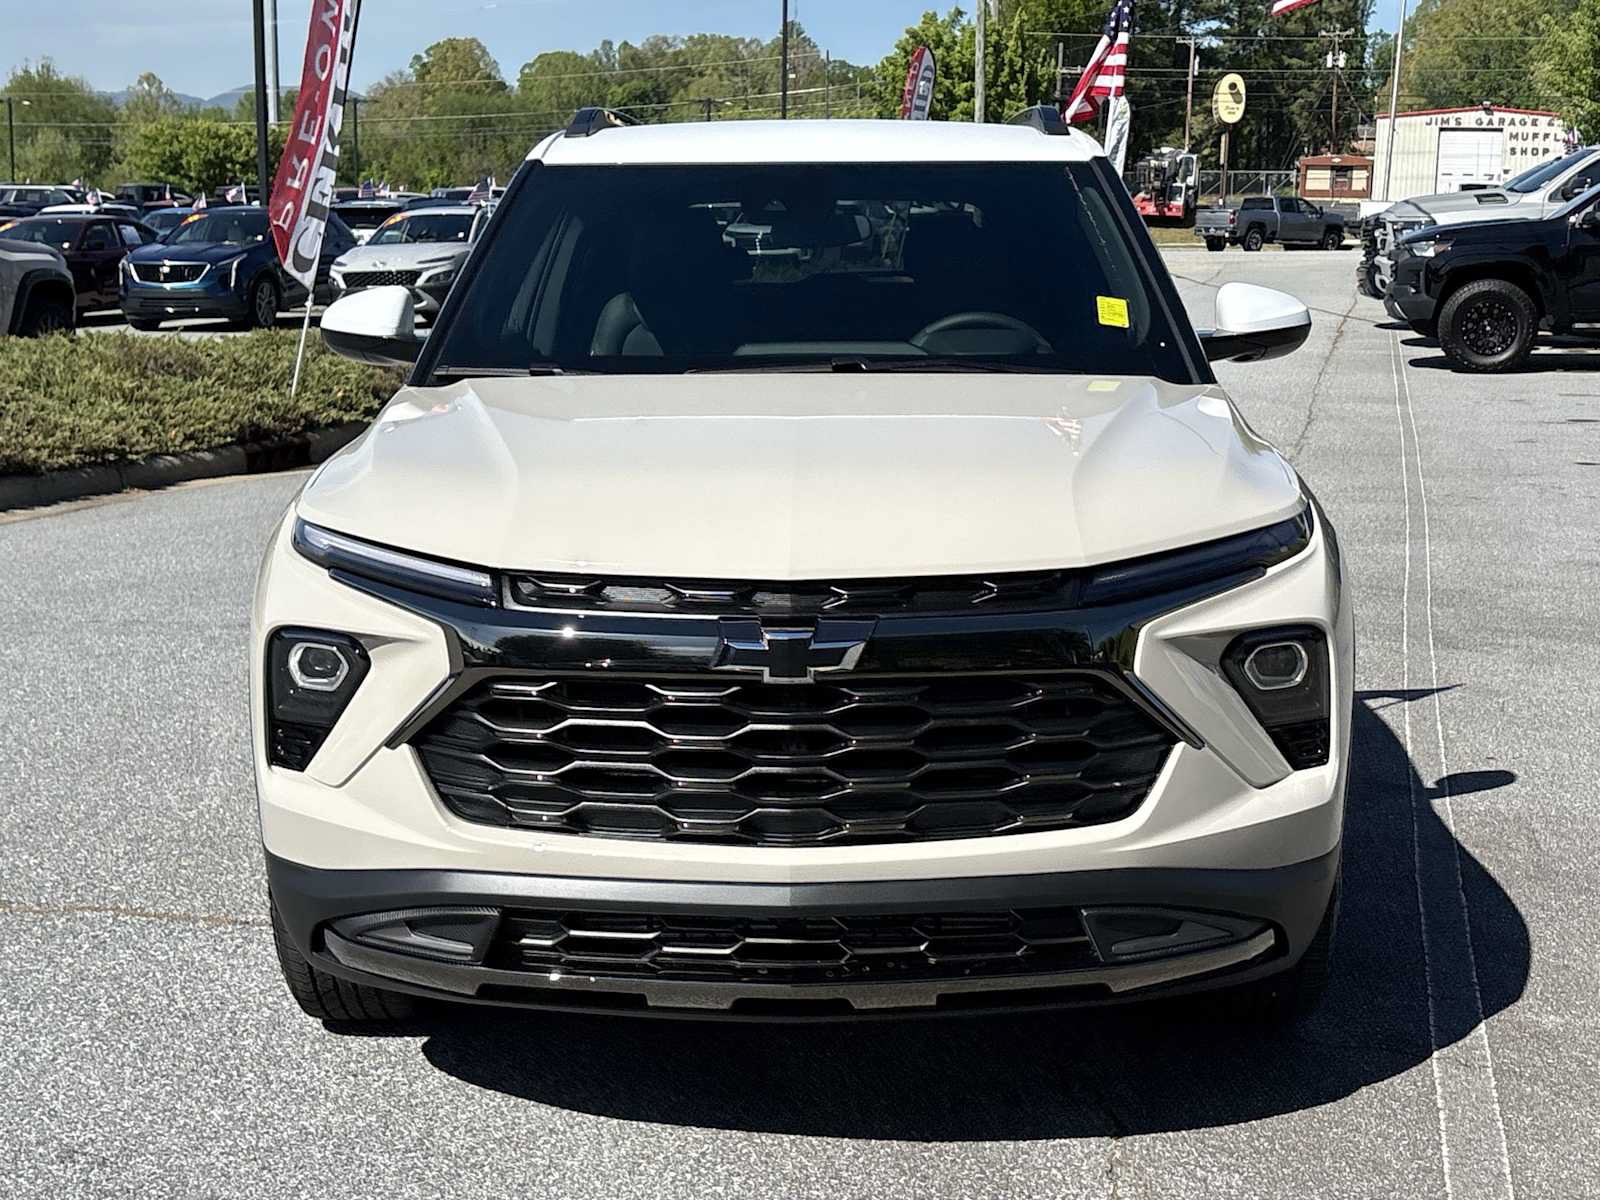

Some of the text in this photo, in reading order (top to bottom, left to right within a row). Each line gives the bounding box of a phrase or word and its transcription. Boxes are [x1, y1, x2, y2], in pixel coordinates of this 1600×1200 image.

[1425, 116, 1463, 127] JIM'S
[1475, 117, 1539, 127] GARAGE
[1509, 131, 1561, 142] MUFFL
[1510, 147, 1550, 157] SHOP
